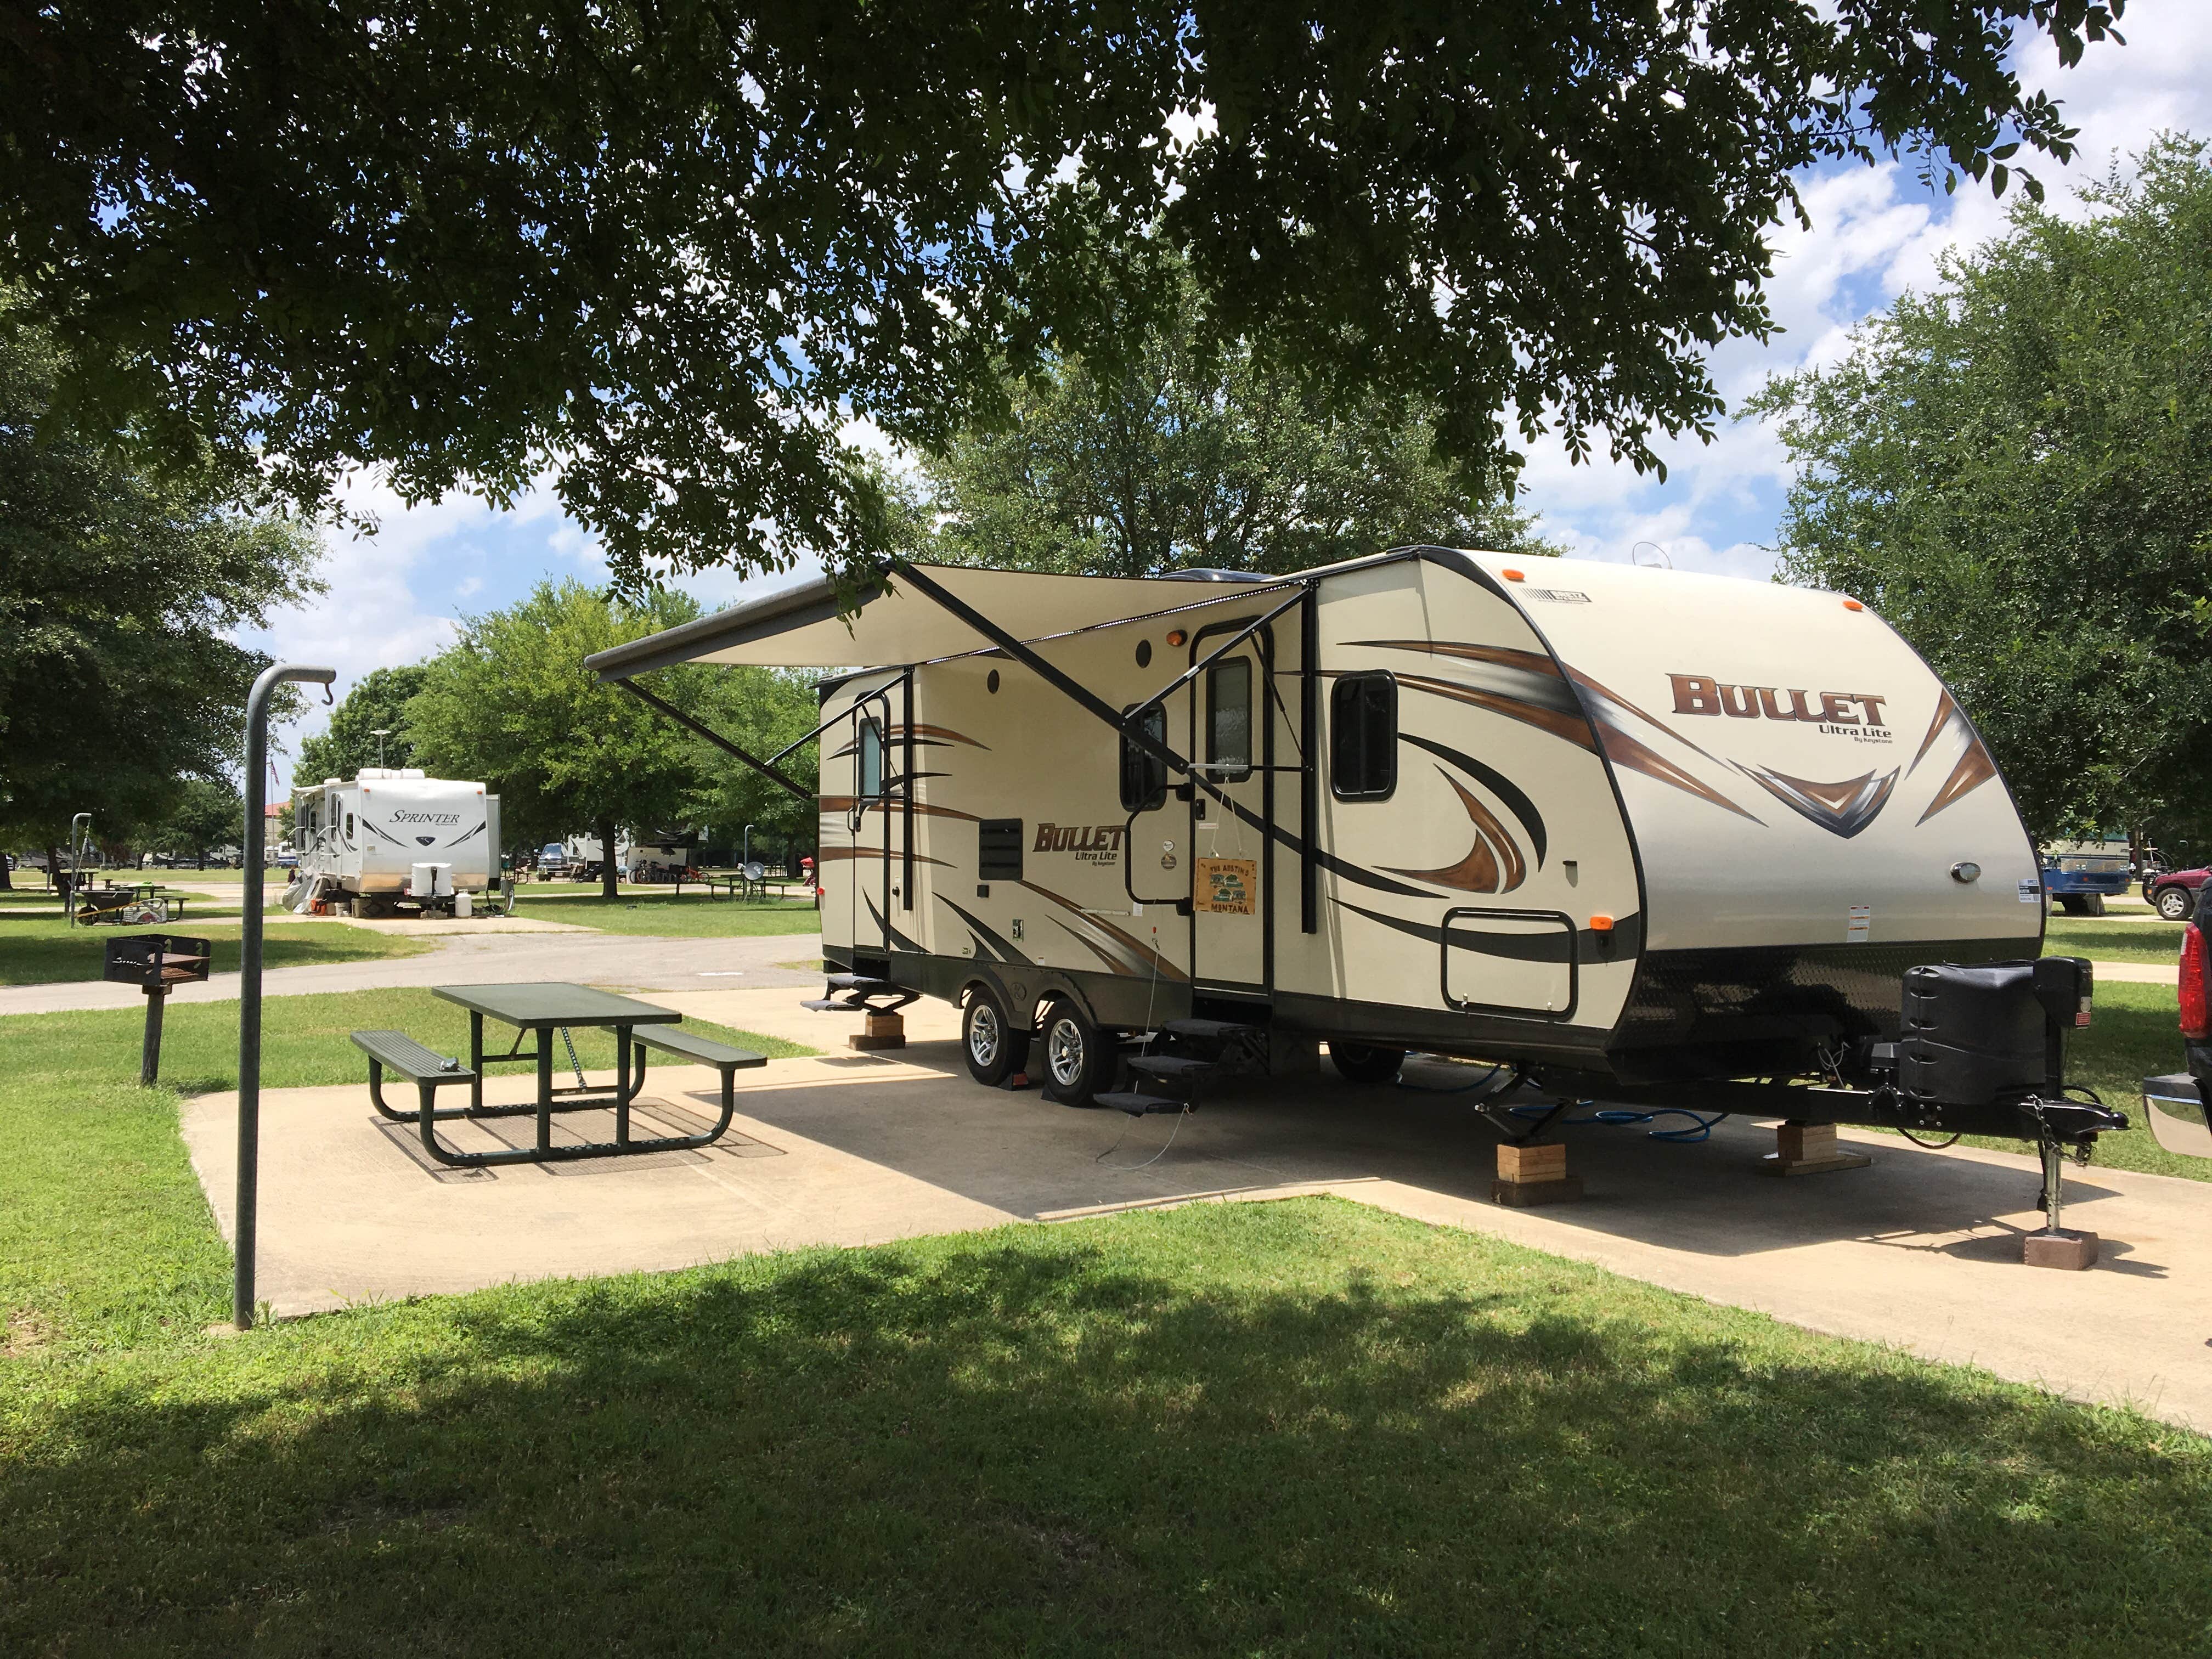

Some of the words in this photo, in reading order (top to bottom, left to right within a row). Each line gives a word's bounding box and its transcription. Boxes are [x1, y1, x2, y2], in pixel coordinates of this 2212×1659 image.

[1664, 673, 1887, 726] BULLET
[1819, 724, 1859, 736] Ultra
[1863, 727, 1892, 738] Lite
[389, 810, 460, 823] SPRINTER
[1032, 822, 1128, 852] BULLET
[1075, 851, 1097, 860] Ultra
[1099, 851, 1117, 860] Lite
[1211, 904, 1248, 913] MONTANA
